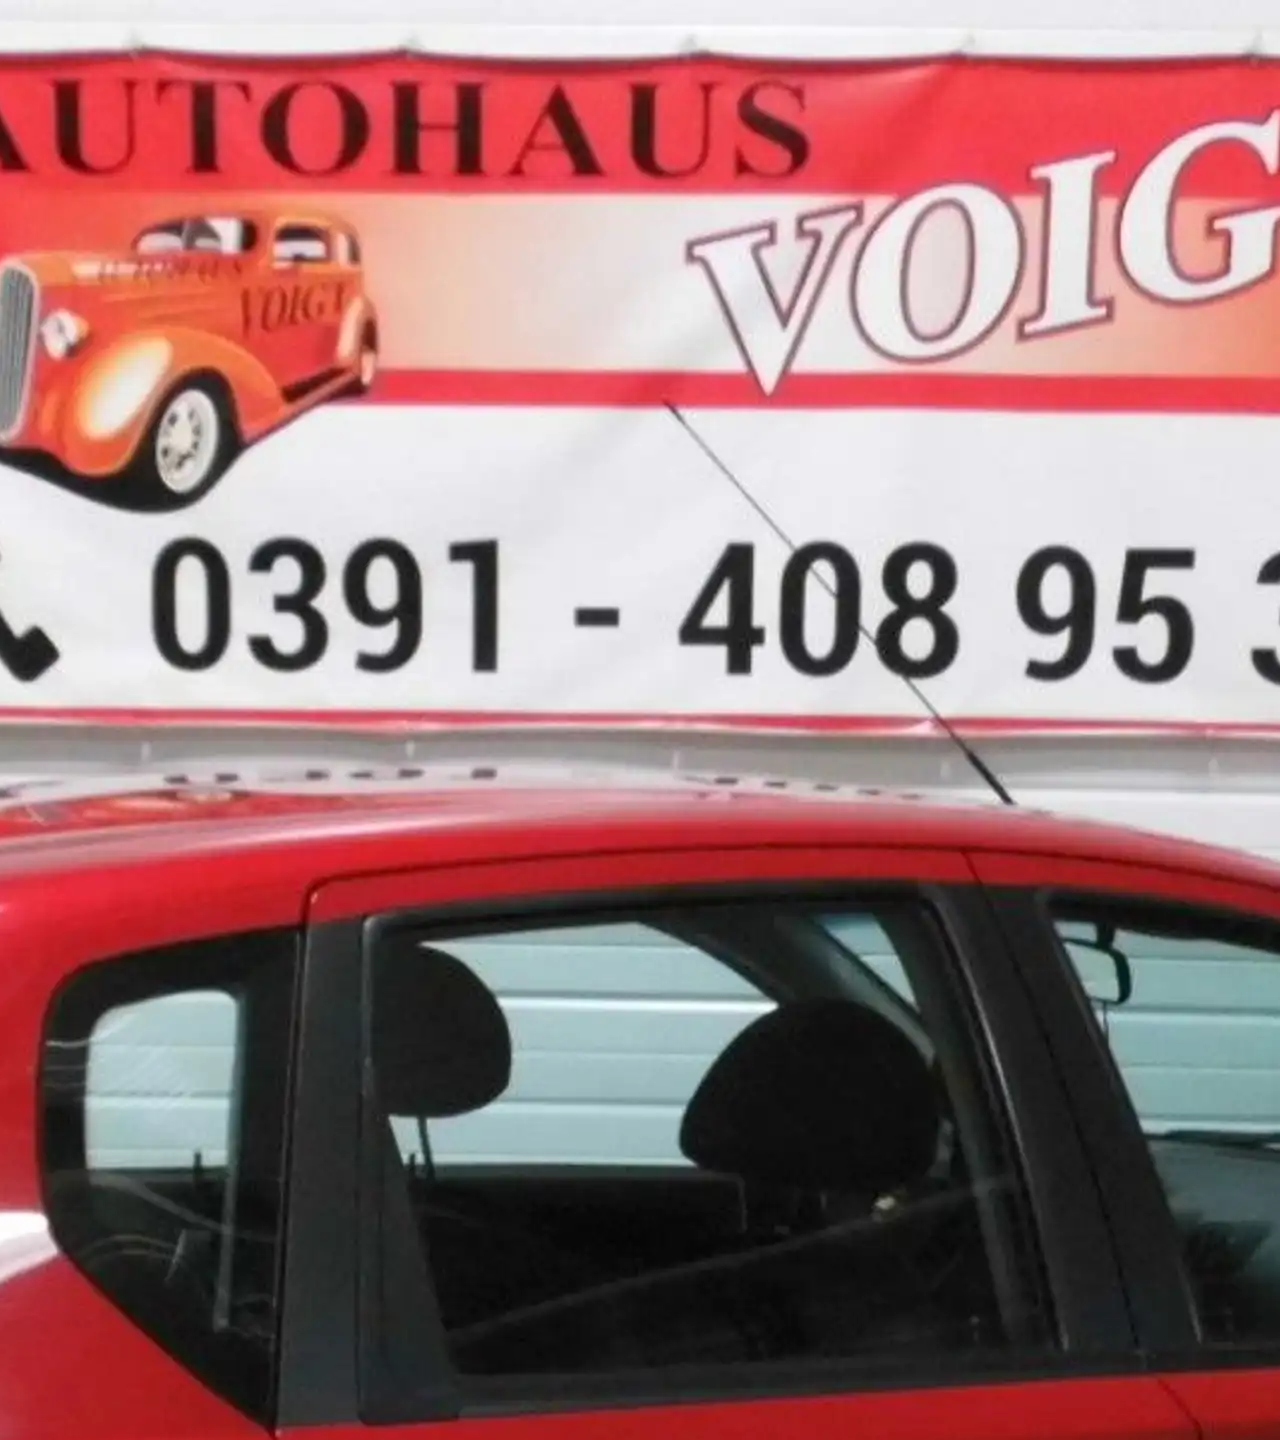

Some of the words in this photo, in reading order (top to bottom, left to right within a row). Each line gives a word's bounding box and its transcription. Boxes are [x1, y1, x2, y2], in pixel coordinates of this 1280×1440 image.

[152, 536, 499, 672] 0391
[575, 607, 620, 627] -
[678, 541, 960, 681] 408
[1015, 545, 1197, 684] 95
